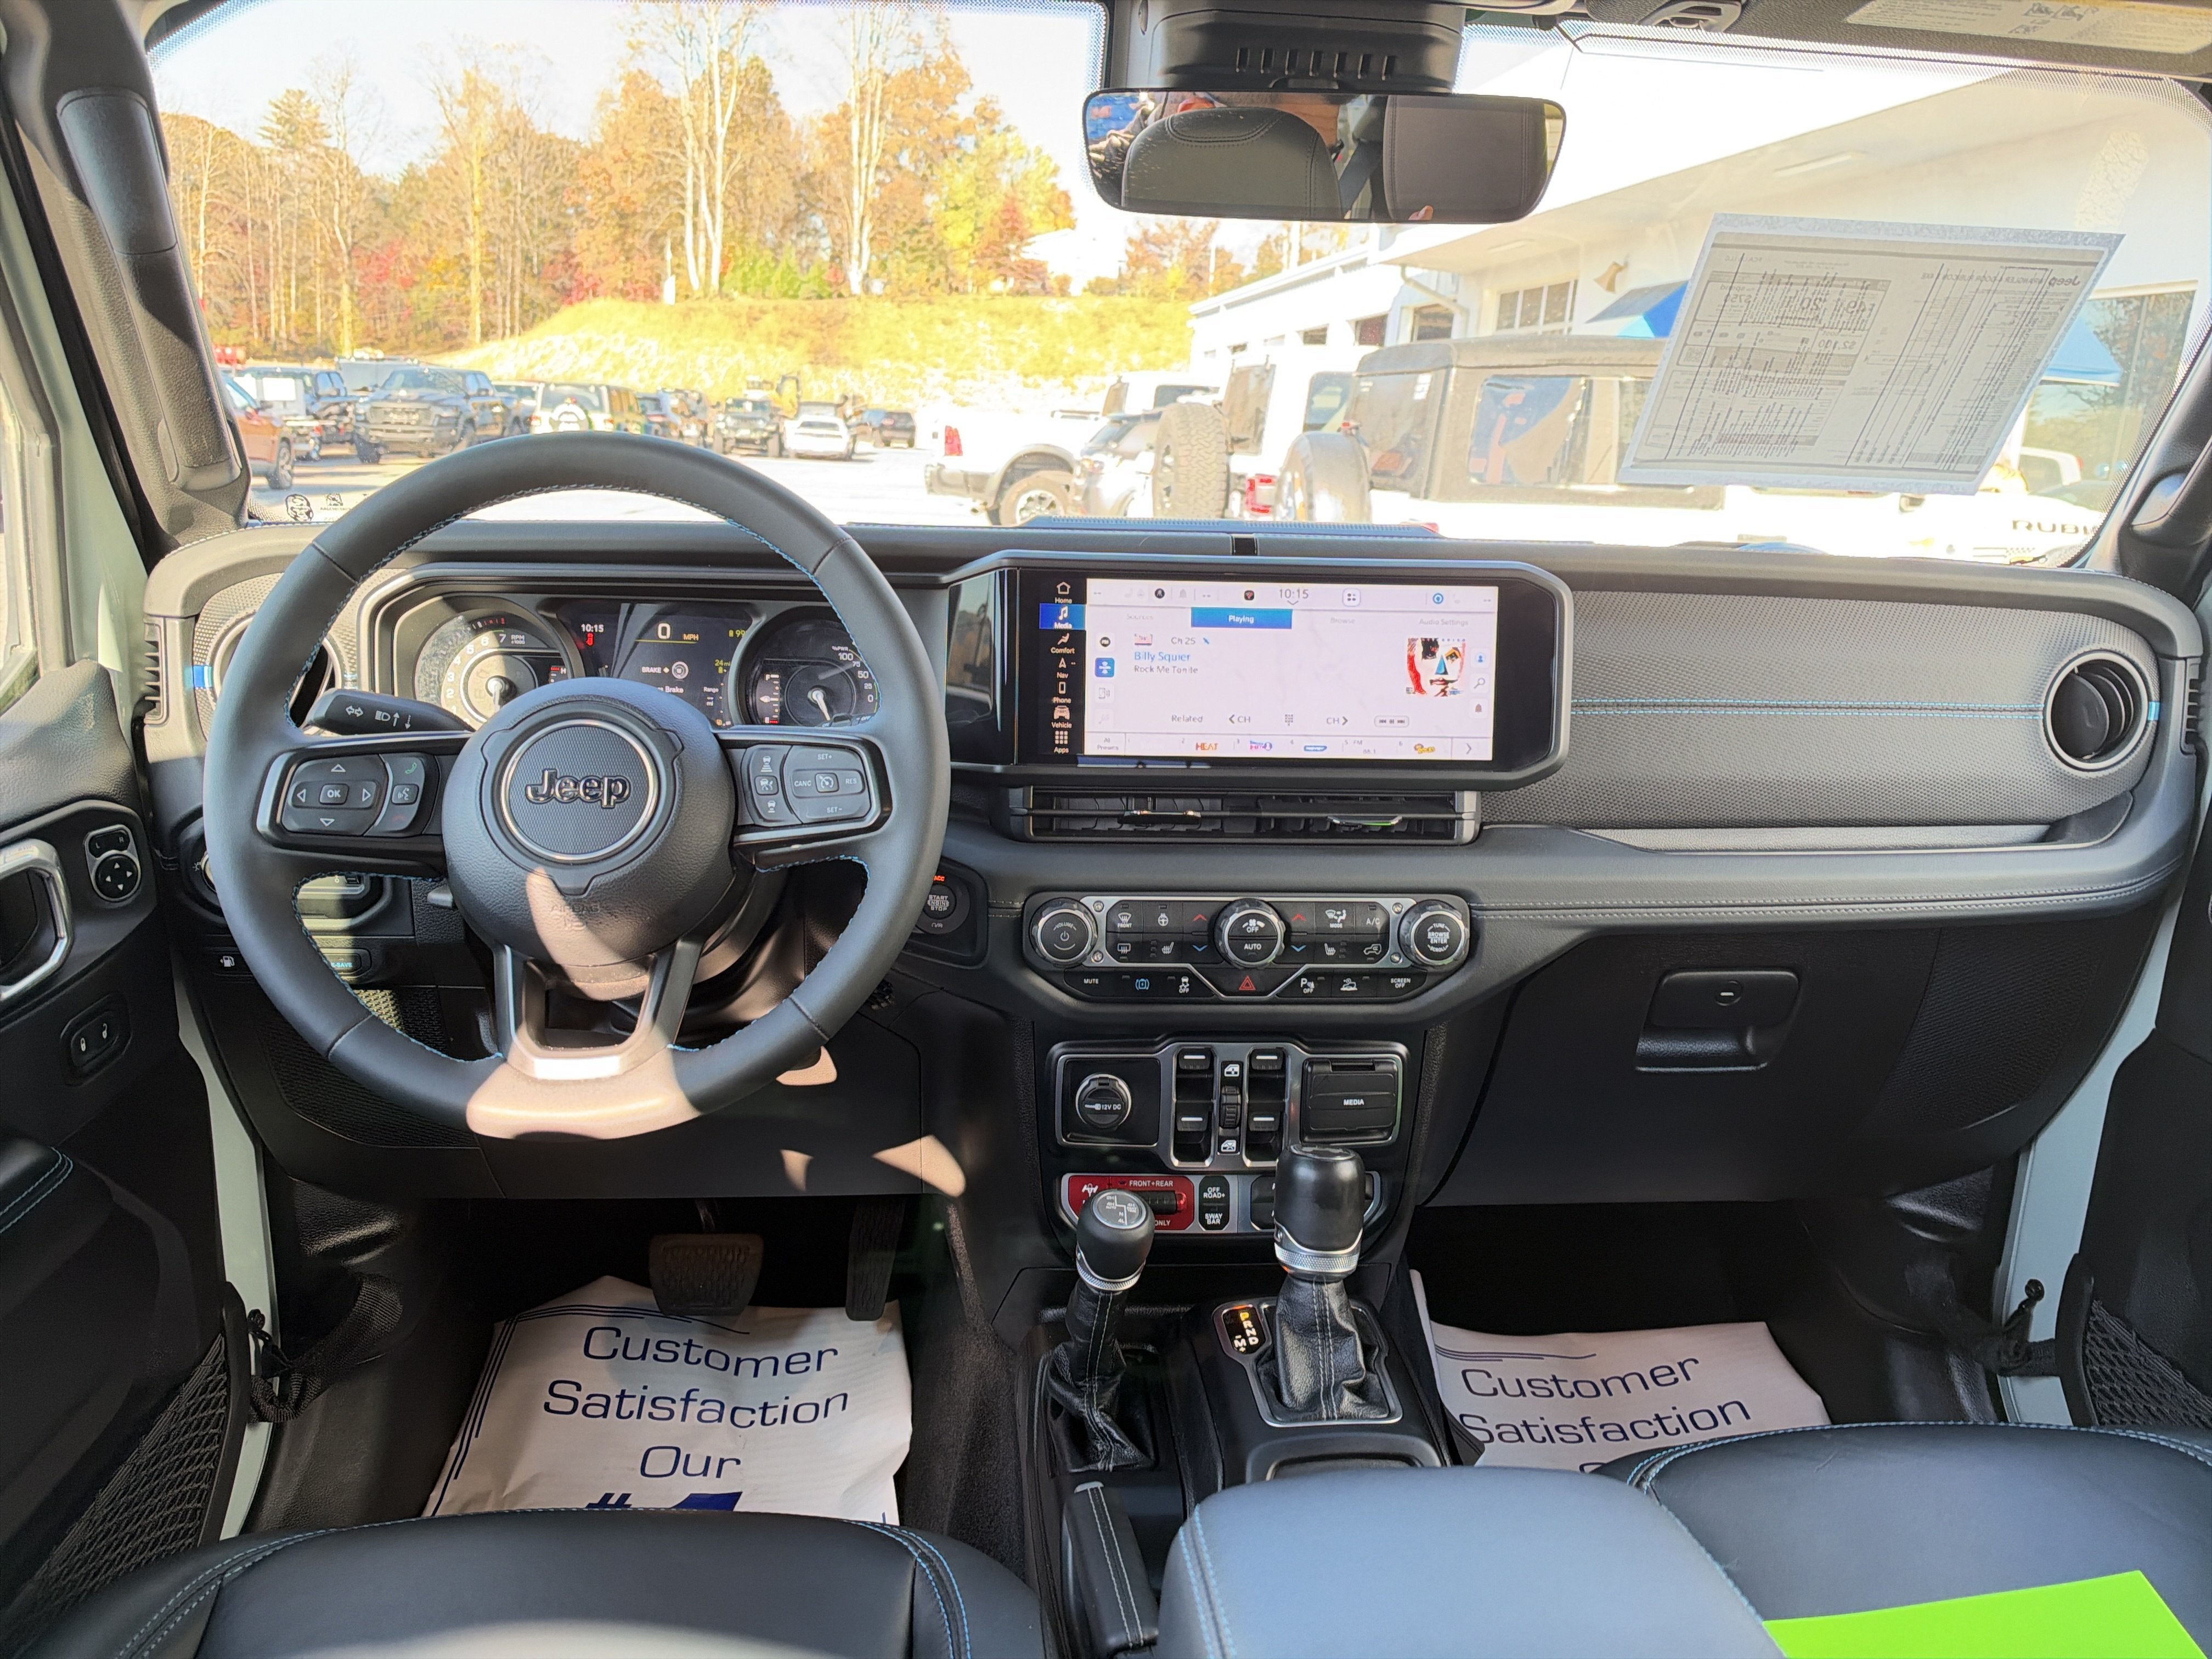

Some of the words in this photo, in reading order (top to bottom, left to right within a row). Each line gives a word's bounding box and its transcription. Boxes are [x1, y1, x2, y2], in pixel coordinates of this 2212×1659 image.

[1279, 589, 1309, 599] 10:15
[1228, 615, 1255, 624] Playing
[1441, 619, 1469, 627] Settings
[580, 624, 604, 633] 10:15
[658, 623, 671, 639] 0
[499, 634, 506, 643] 7
[838, 652, 854, 661] 100
[1134, 651, 1155, 662] Billy
[1158, 652, 1190, 663] Squier
[858, 670, 868, 679] 50
[1171, 714, 1203, 723] Related
[1195, 742, 1218, 751] HEAT
[525, 768, 631, 809] Jeep
[327, 789, 341, 798] OK
[1366, 917, 1380, 926] A/C
[1239, 1312, 1250, 1321] P
[1243, 1320, 1253, 1328] R
[1246, 1328, 1257, 1337] N
[1248, 1336, 1259, 1345] D
[583, 1326, 838, 1378] Customer
[1461, 1357, 1699, 1399] Customer
[543, 1379, 848, 1429] Satisfaction
[1459, 1400, 1751, 1444] Satisfaction
[640, 1445, 741, 1479] Our
